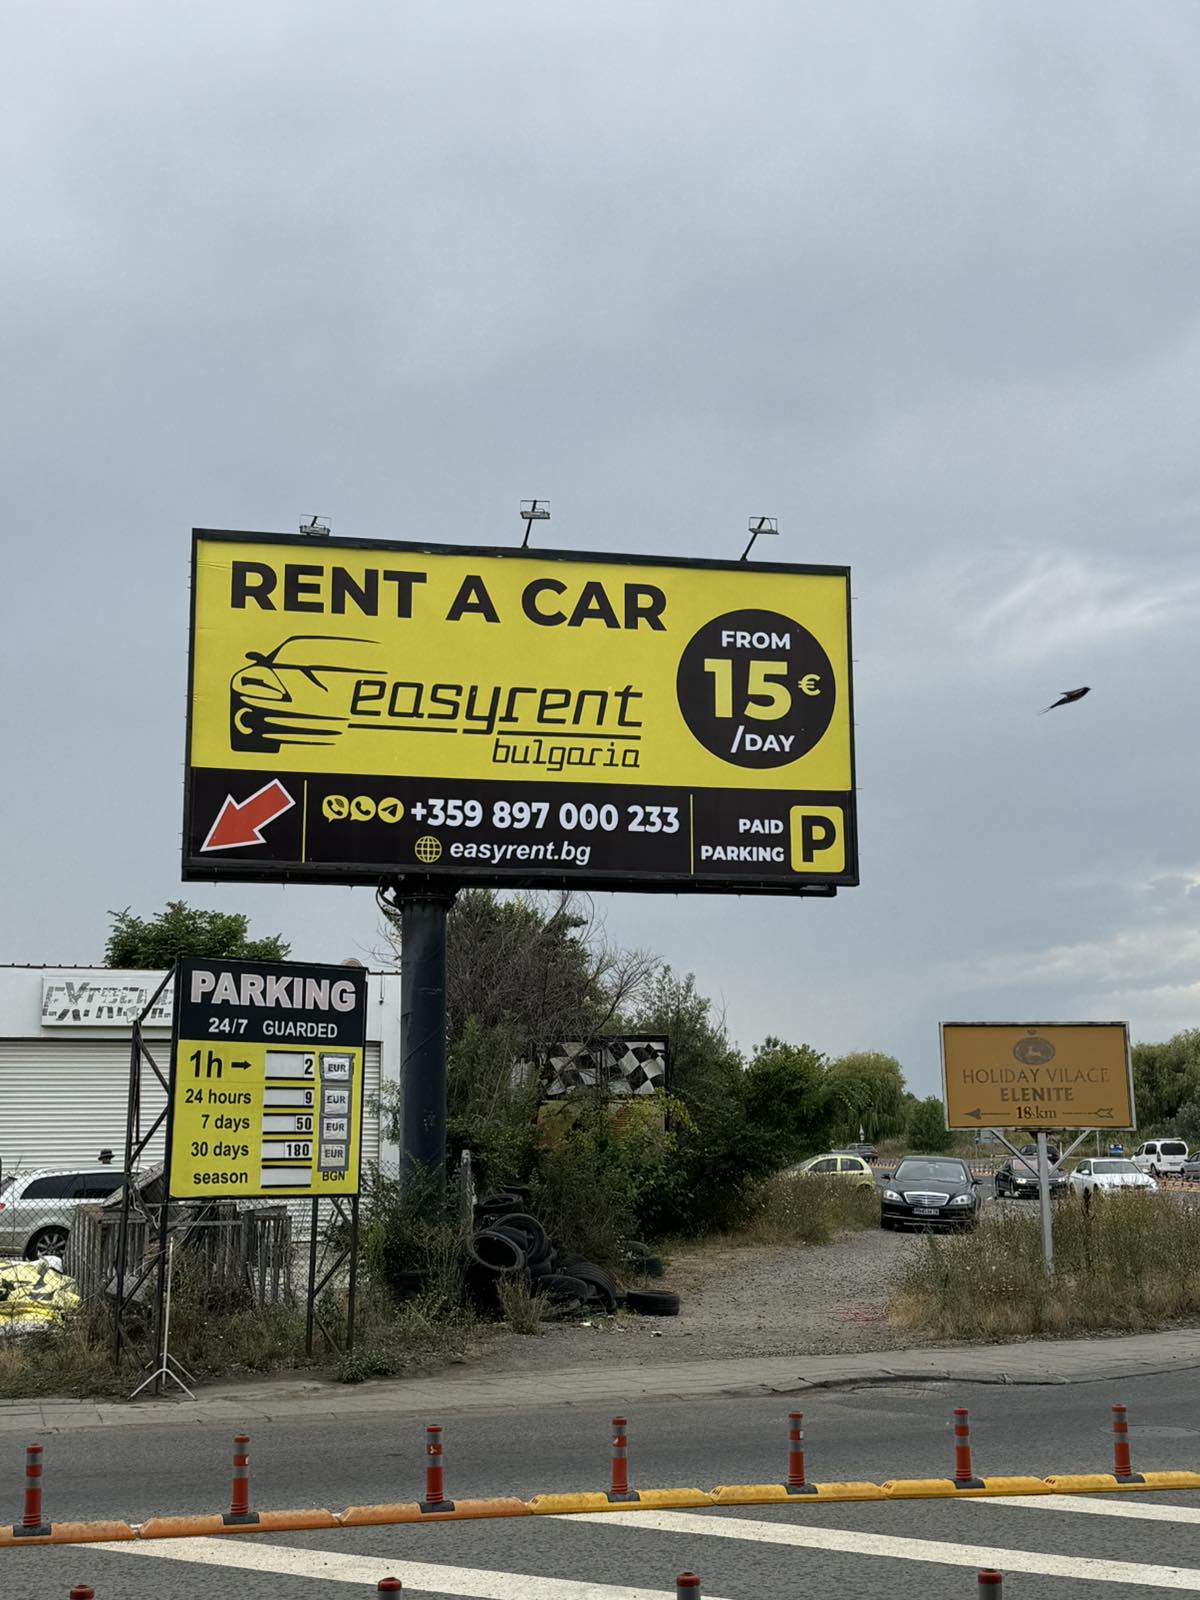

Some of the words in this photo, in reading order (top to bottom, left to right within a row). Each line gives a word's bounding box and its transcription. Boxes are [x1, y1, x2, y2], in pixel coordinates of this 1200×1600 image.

[231, 561, 426, 618] RENT
[446, 575, 500, 623] A
[521, 578, 667, 631] CAR
[720, 630, 791, 650] FROM
[704, 658, 792, 721] 15
[798, 673, 821, 696] €
[350, 679, 643, 733] easyrent
[730, 725, 795, 753] /DAY
[491, 738, 641, 772] bulgaria
[410, 798, 483, 828] +359
[492, 801, 550, 829] 897
[559, 803, 619, 831] 000
[627, 805, 680, 833] 233
[738, 818, 784, 835] PAID
[801, 815, 836, 862] P
[449, 841, 591, 865] easyrent.bg
[701, 844, 785, 863] PARKING
[190, 970, 356, 1012] PARKING
[208, 1018, 248, 1034] 24/7
[263, 1020, 338, 1038] GUARDED
[190, 1050, 223, 1078] 1h
[304, 1058, 313, 1076] 2
[328, 1064, 346, 1073] EUR
[963, 1068, 1040, 1084] HOLIDAY
[185, 1088, 203, 1104] 24
[208, 1089, 252, 1104] hours
[305, 1091, 312, 1104] 9
[327, 1095, 346, 1104] EUR
[1000, 1087, 1074, 1102] ELENITE
[202, 1114, 210, 1129] 7
[214, 1113, 250, 1132] days
[296, 1117, 312, 1130] 50
[326, 1122, 345, 1132] EUR
[1016, 1106, 1033, 1119] 18
[1035, 1106, 1057, 1119] km
[191, 1142, 208, 1157] 30
[213, 1141, 249, 1160] days
[287, 1144, 310, 1157] 180
[324, 1149, 343, 1159] EUR
[193, 1172, 248, 1185] season
[322, 1171, 345, 1182] BGN
